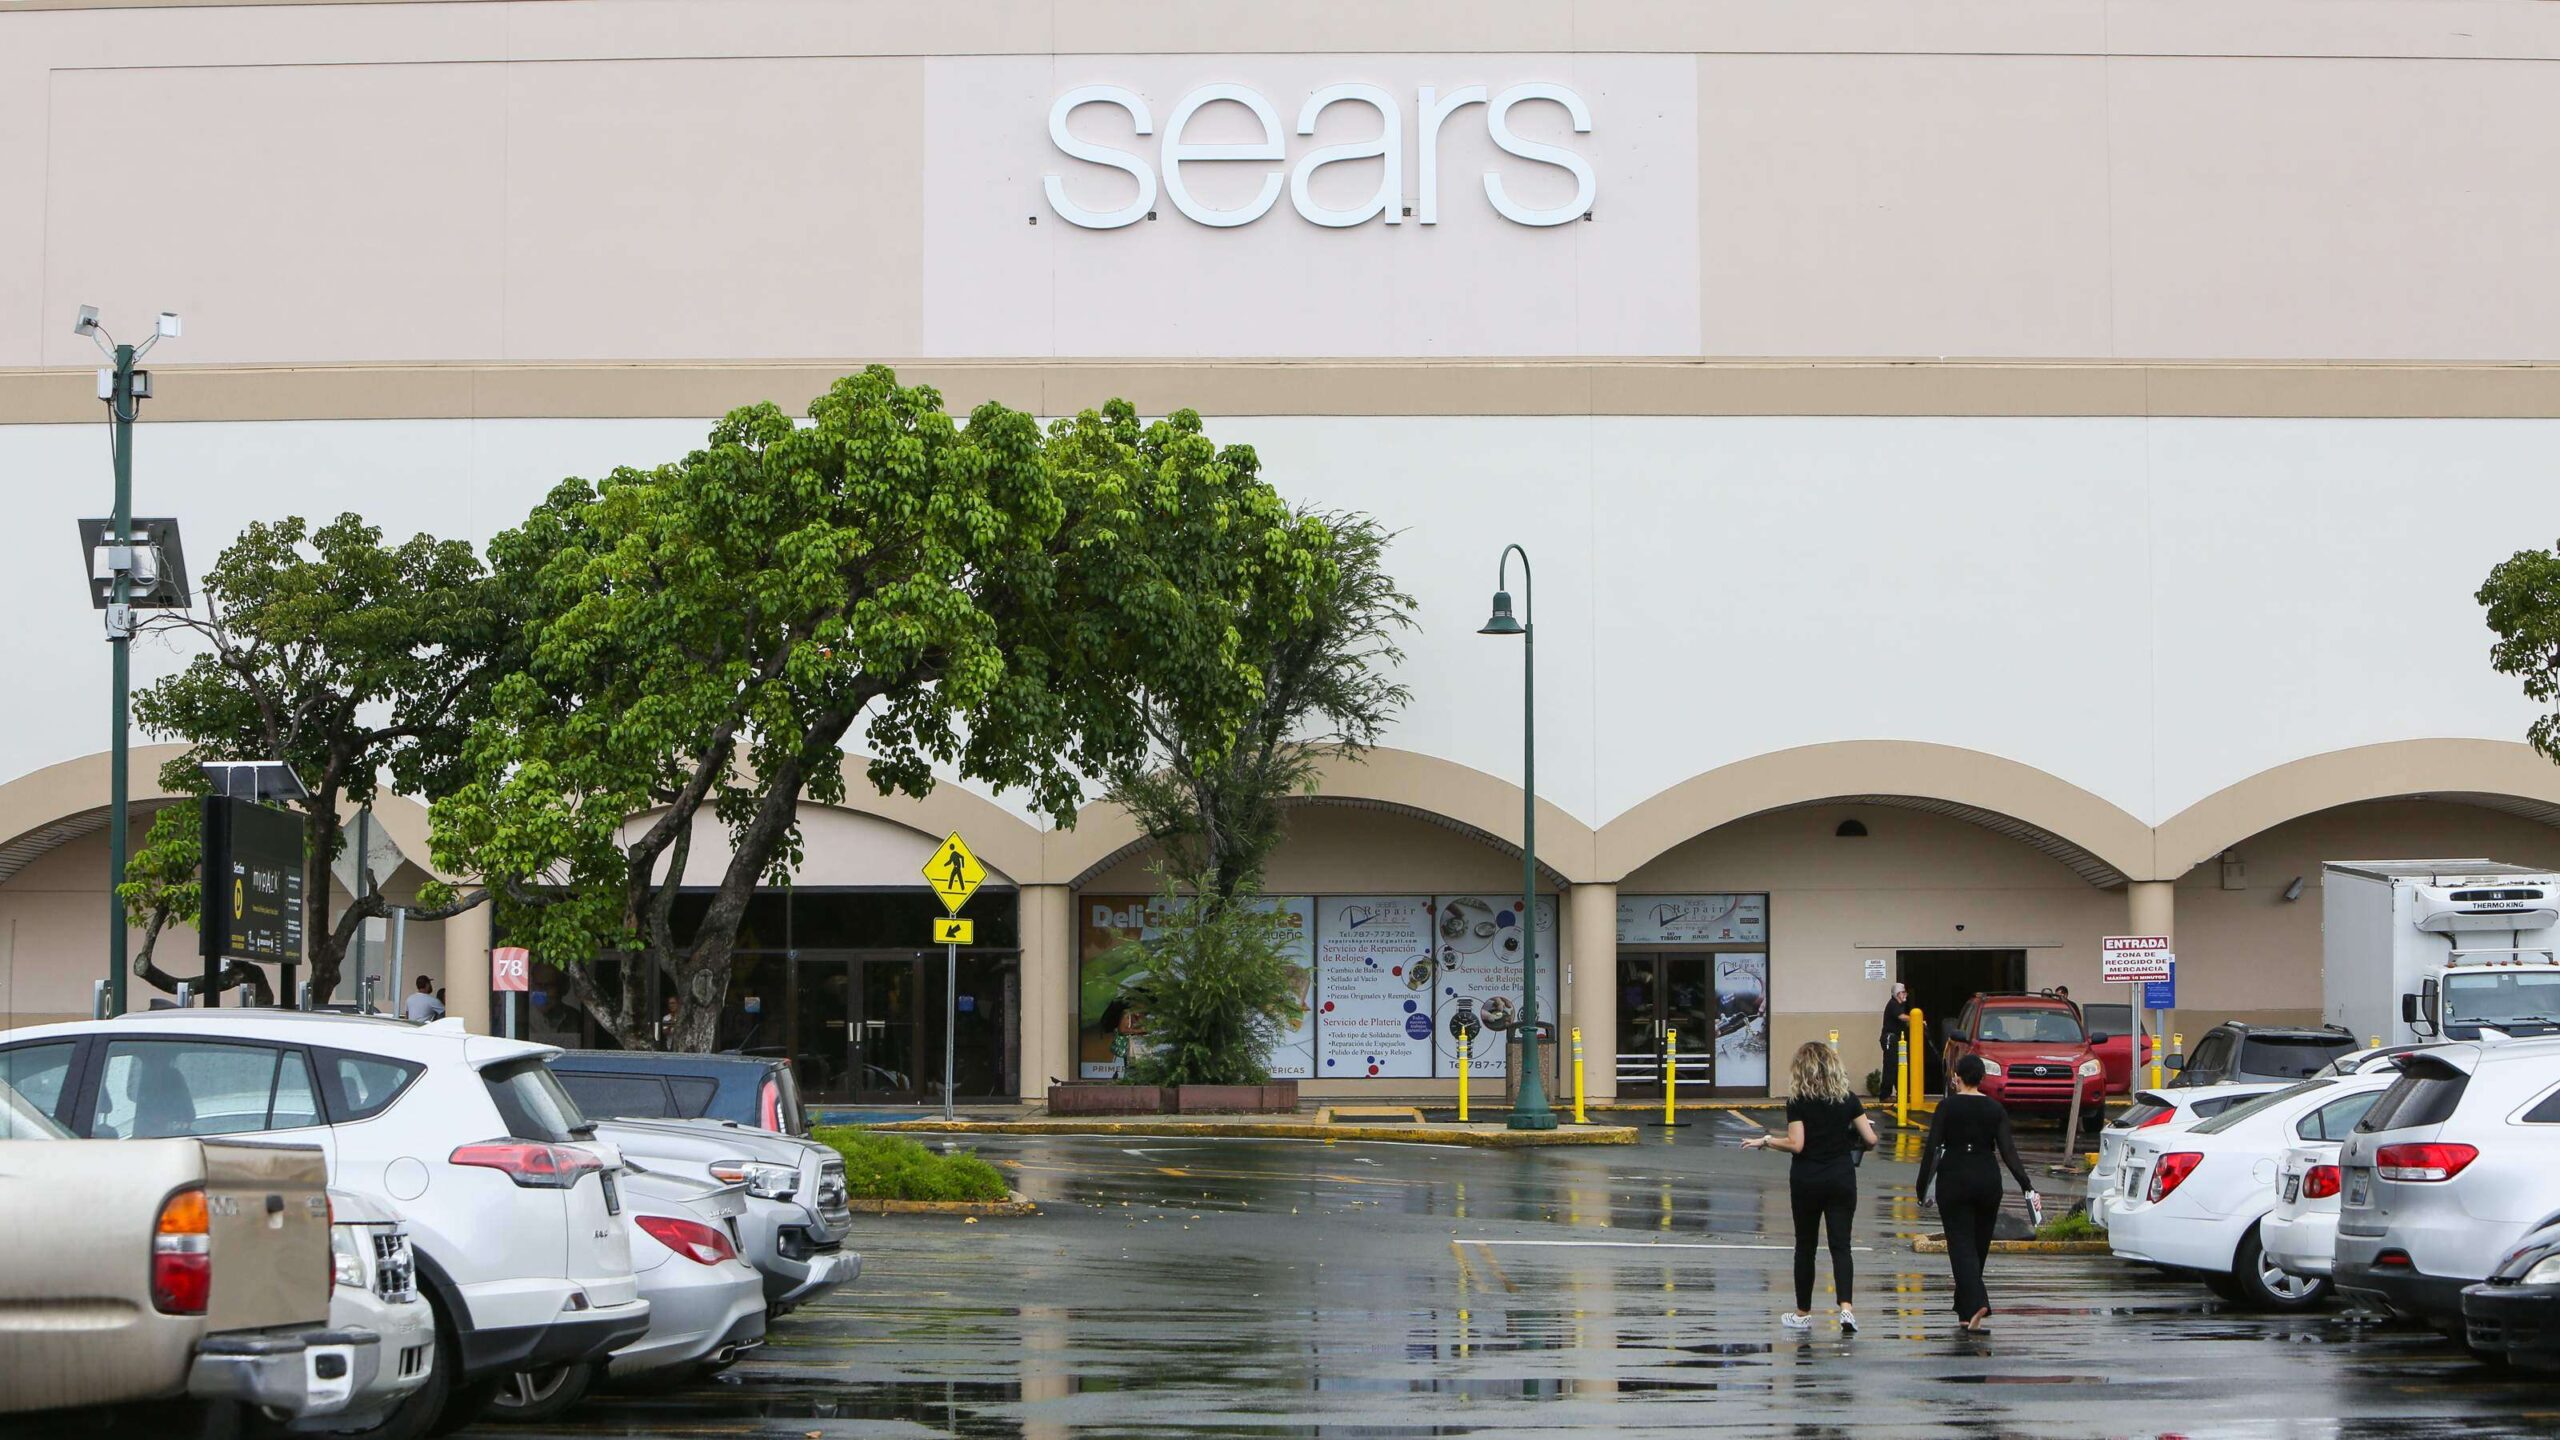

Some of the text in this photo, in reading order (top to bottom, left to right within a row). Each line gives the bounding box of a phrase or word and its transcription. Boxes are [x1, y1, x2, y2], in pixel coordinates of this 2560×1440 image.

[1043, 81, 1597, 229] sears
[1364, 906, 1416, 917] Repair
[1673, 904, 1724, 916] Repair
[2105, 938, 2167, 949] ENTRADA
[1323, 944, 1416, 954] Servicio de Reparación
[1323, 954, 1365, 964] de Relojes
[499, 959, 523, 977] 78
[1460, 966, 1491, 974] Servicio
[1492, 966, 1502, 974] de
[1484, 975, 1523, 985] de Relojes
[1468, 983, 1540, 991] Servicio de Plaa
[1387, 993, 1421, 1001] Reemplazo
[1323, 1018, 1357, 1026] Servicio
[1358, 1018, 1368, 1026] de
[1390, 1049, 1412, 1057] Relojes
